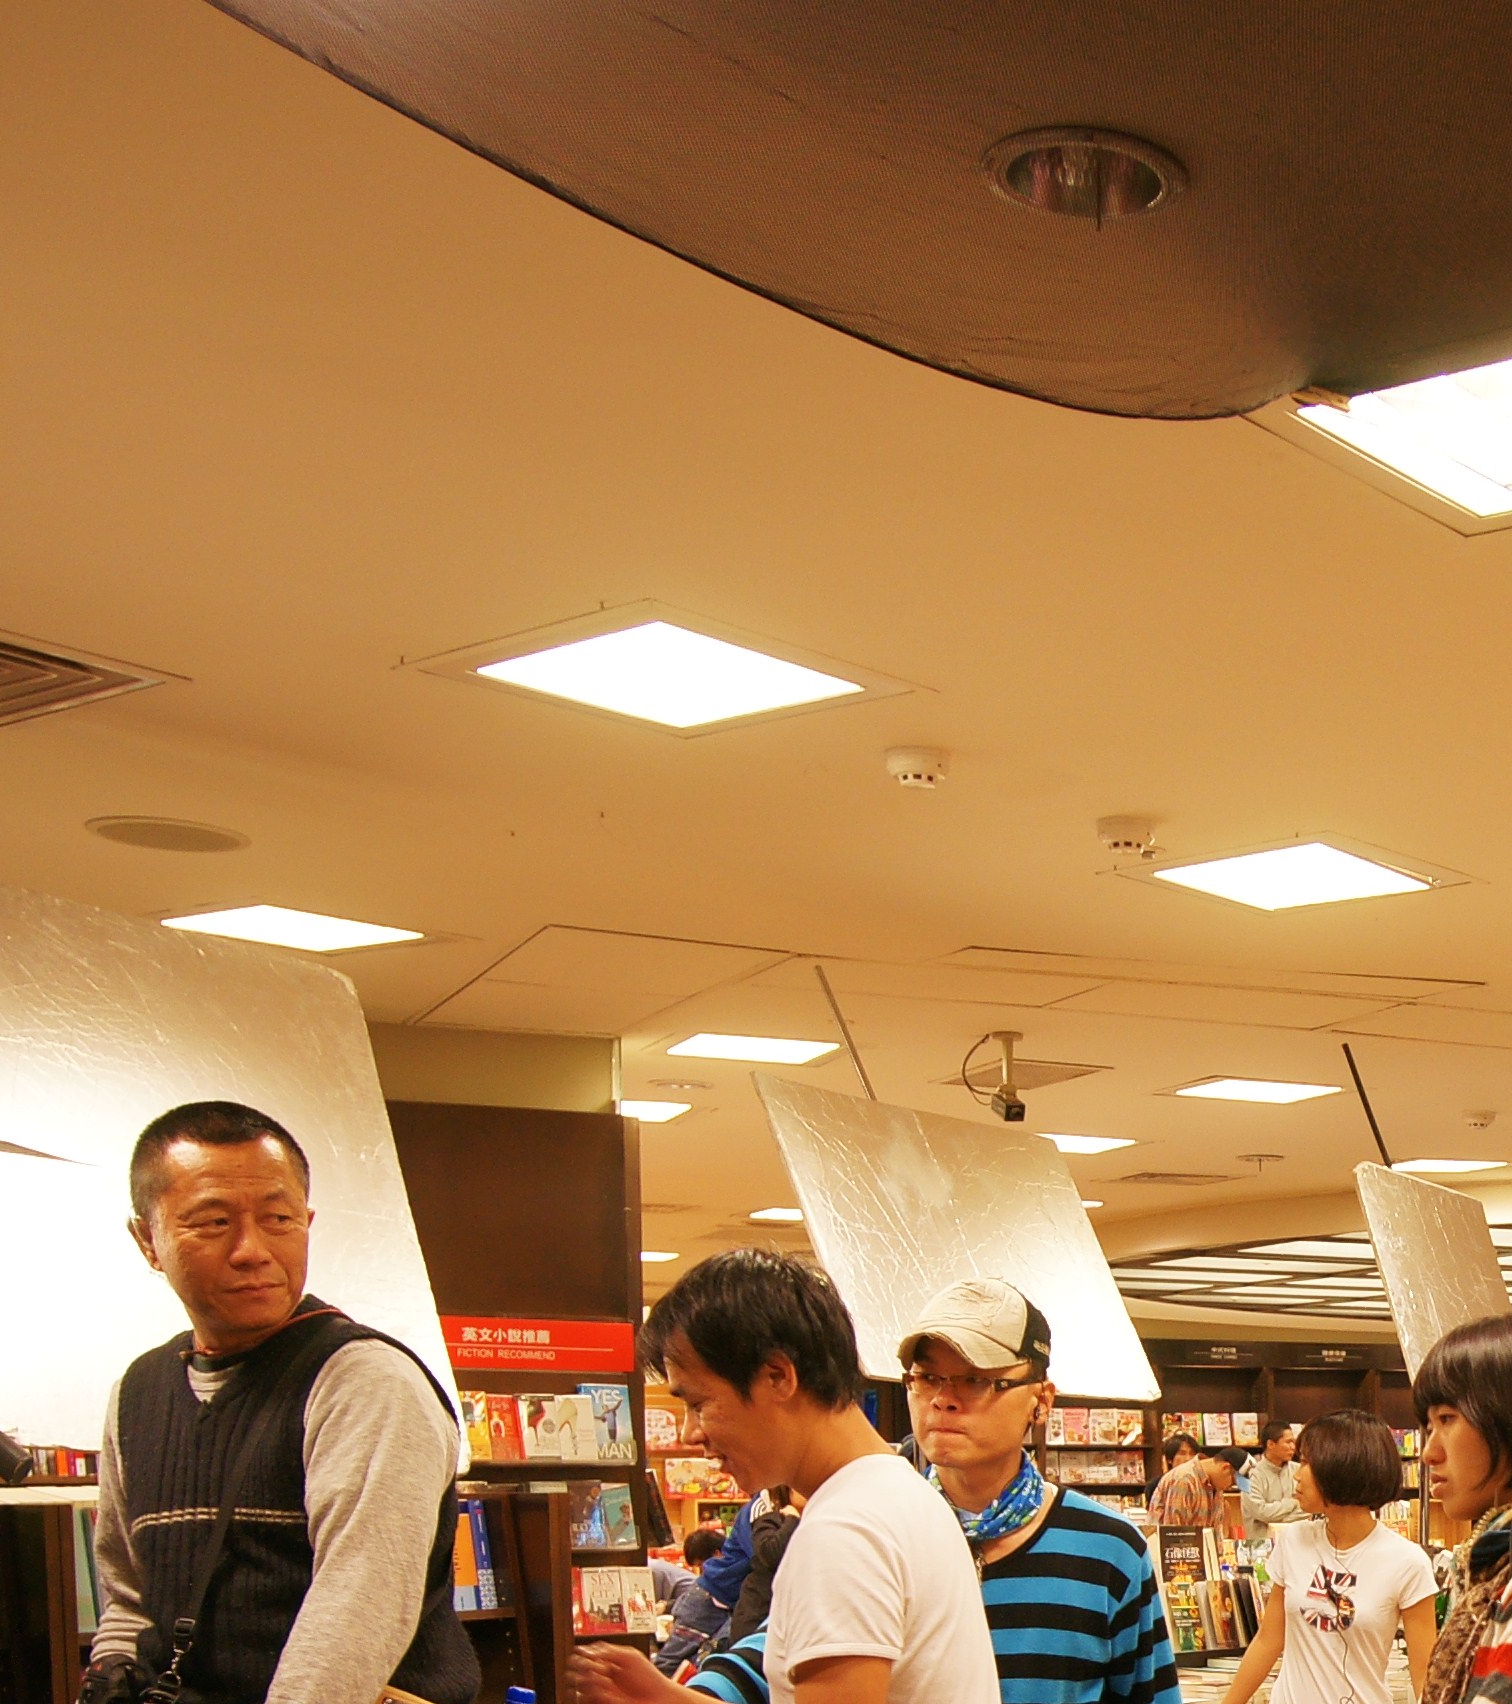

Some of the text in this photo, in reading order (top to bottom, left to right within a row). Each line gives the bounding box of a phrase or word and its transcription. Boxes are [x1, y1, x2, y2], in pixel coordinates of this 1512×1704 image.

[461, 1327, 551, 1345] 英文小說推薦
[457, 1347, 556, 1361] FICTION RECOMMEND
[590, 1389, 624, 1405] YES
[596, 1442, 633, 1459] MAN
